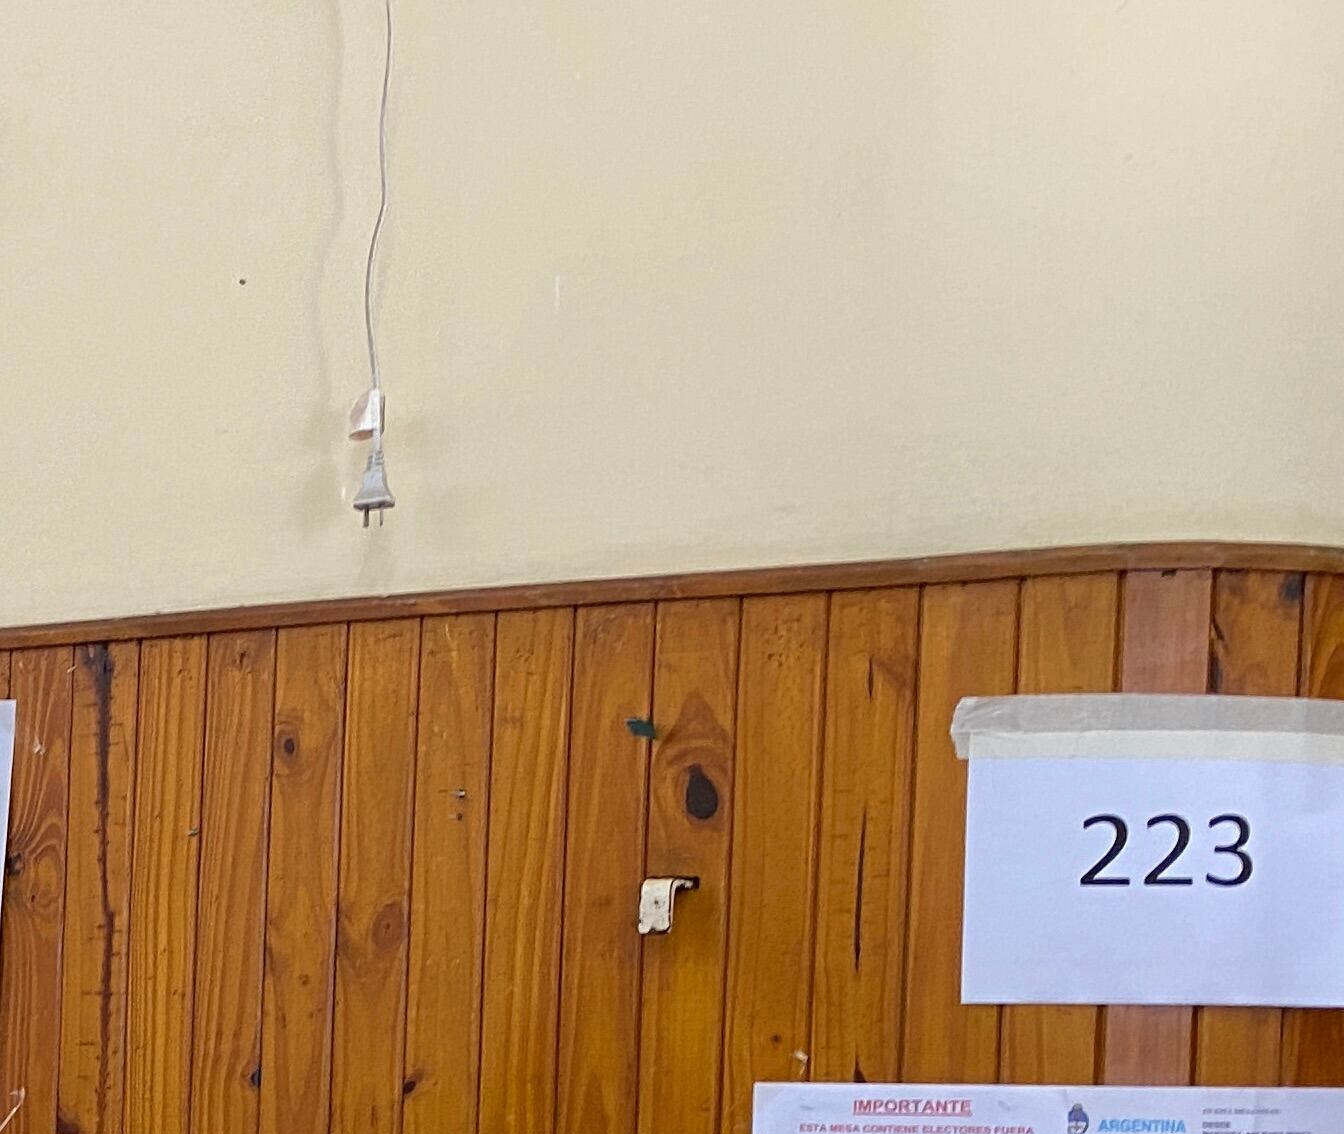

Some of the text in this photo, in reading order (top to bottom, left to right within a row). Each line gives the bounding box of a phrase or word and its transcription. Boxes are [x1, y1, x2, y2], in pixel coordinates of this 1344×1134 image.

[1079, 813, 1255, 888] 223
[853, 1099, 971, 1115] IMPORTANTE
[862, 1124, 920, 1134] CONTIENE
[922, 1125, 992, 1134] ELECTORES
[1097, 1118, 1187, 1133] ARGENTINA
